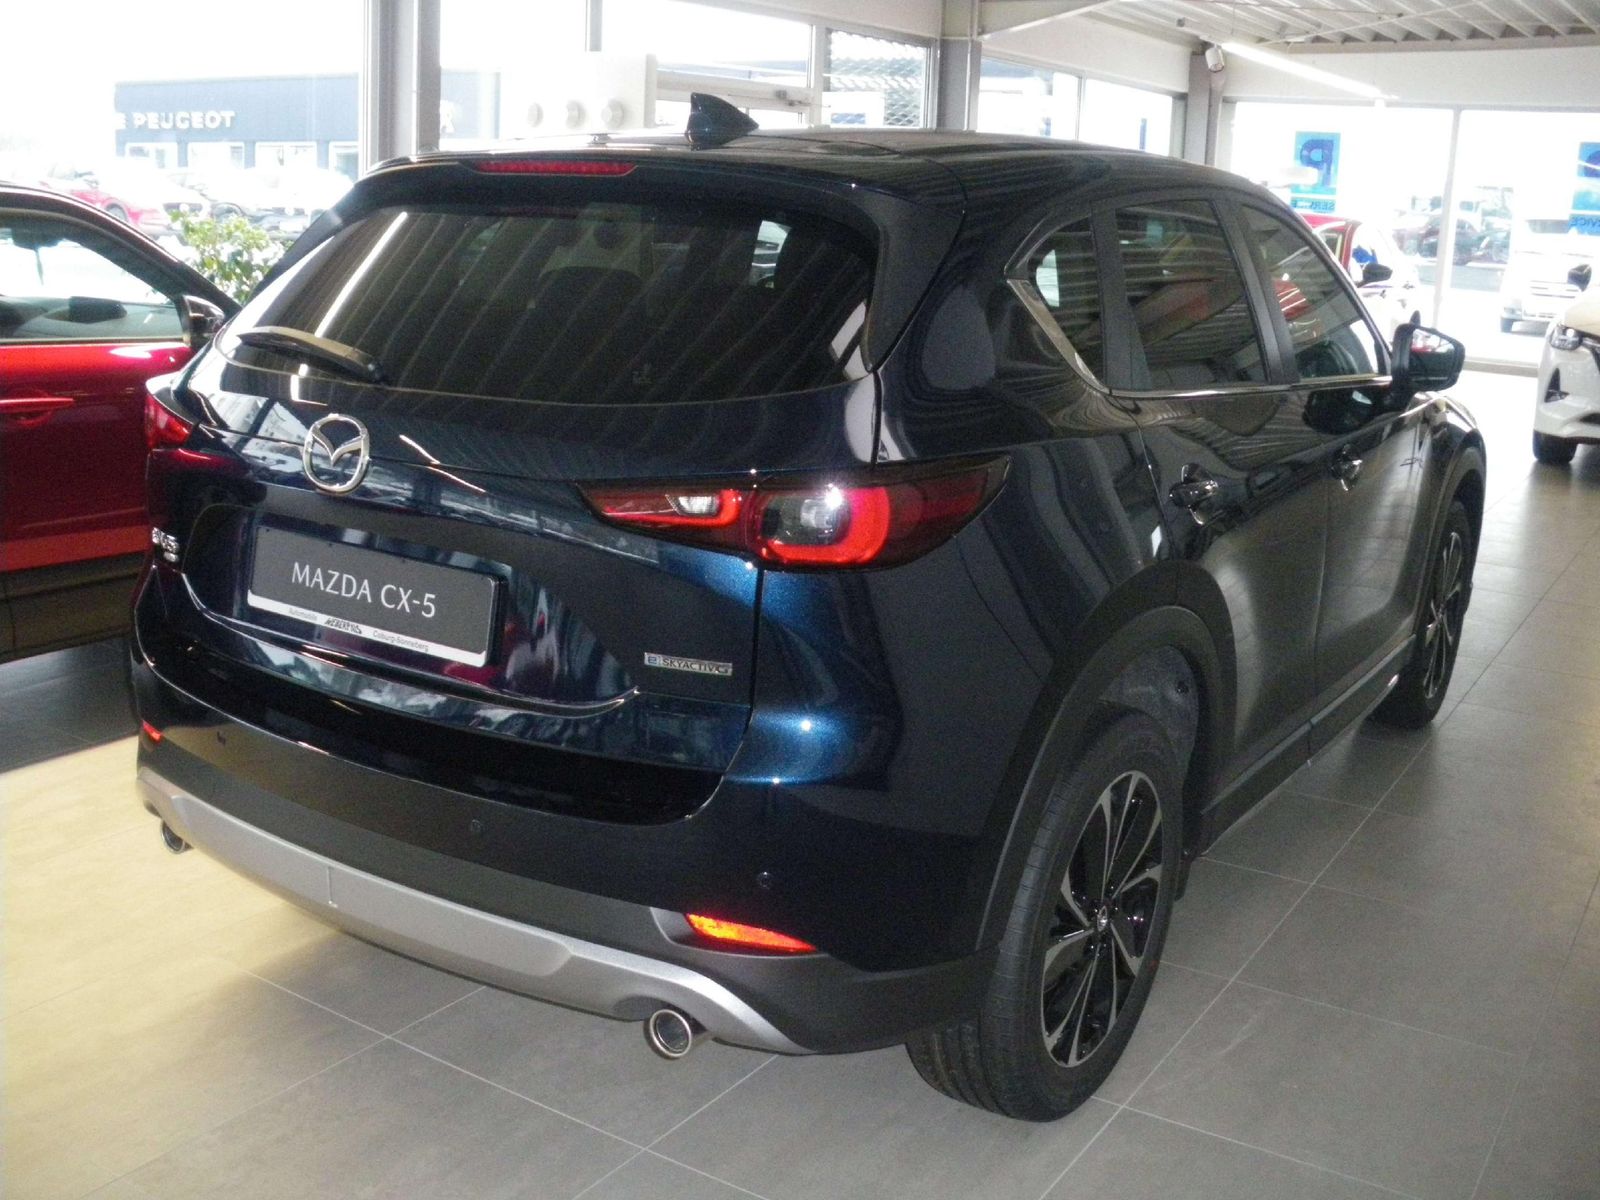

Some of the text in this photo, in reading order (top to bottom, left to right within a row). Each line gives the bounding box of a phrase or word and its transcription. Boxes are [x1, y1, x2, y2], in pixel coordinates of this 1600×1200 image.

[132, 111, 235, 129] PEUGEOT
[291, 561, 436, 618] MAZDA CX-5
